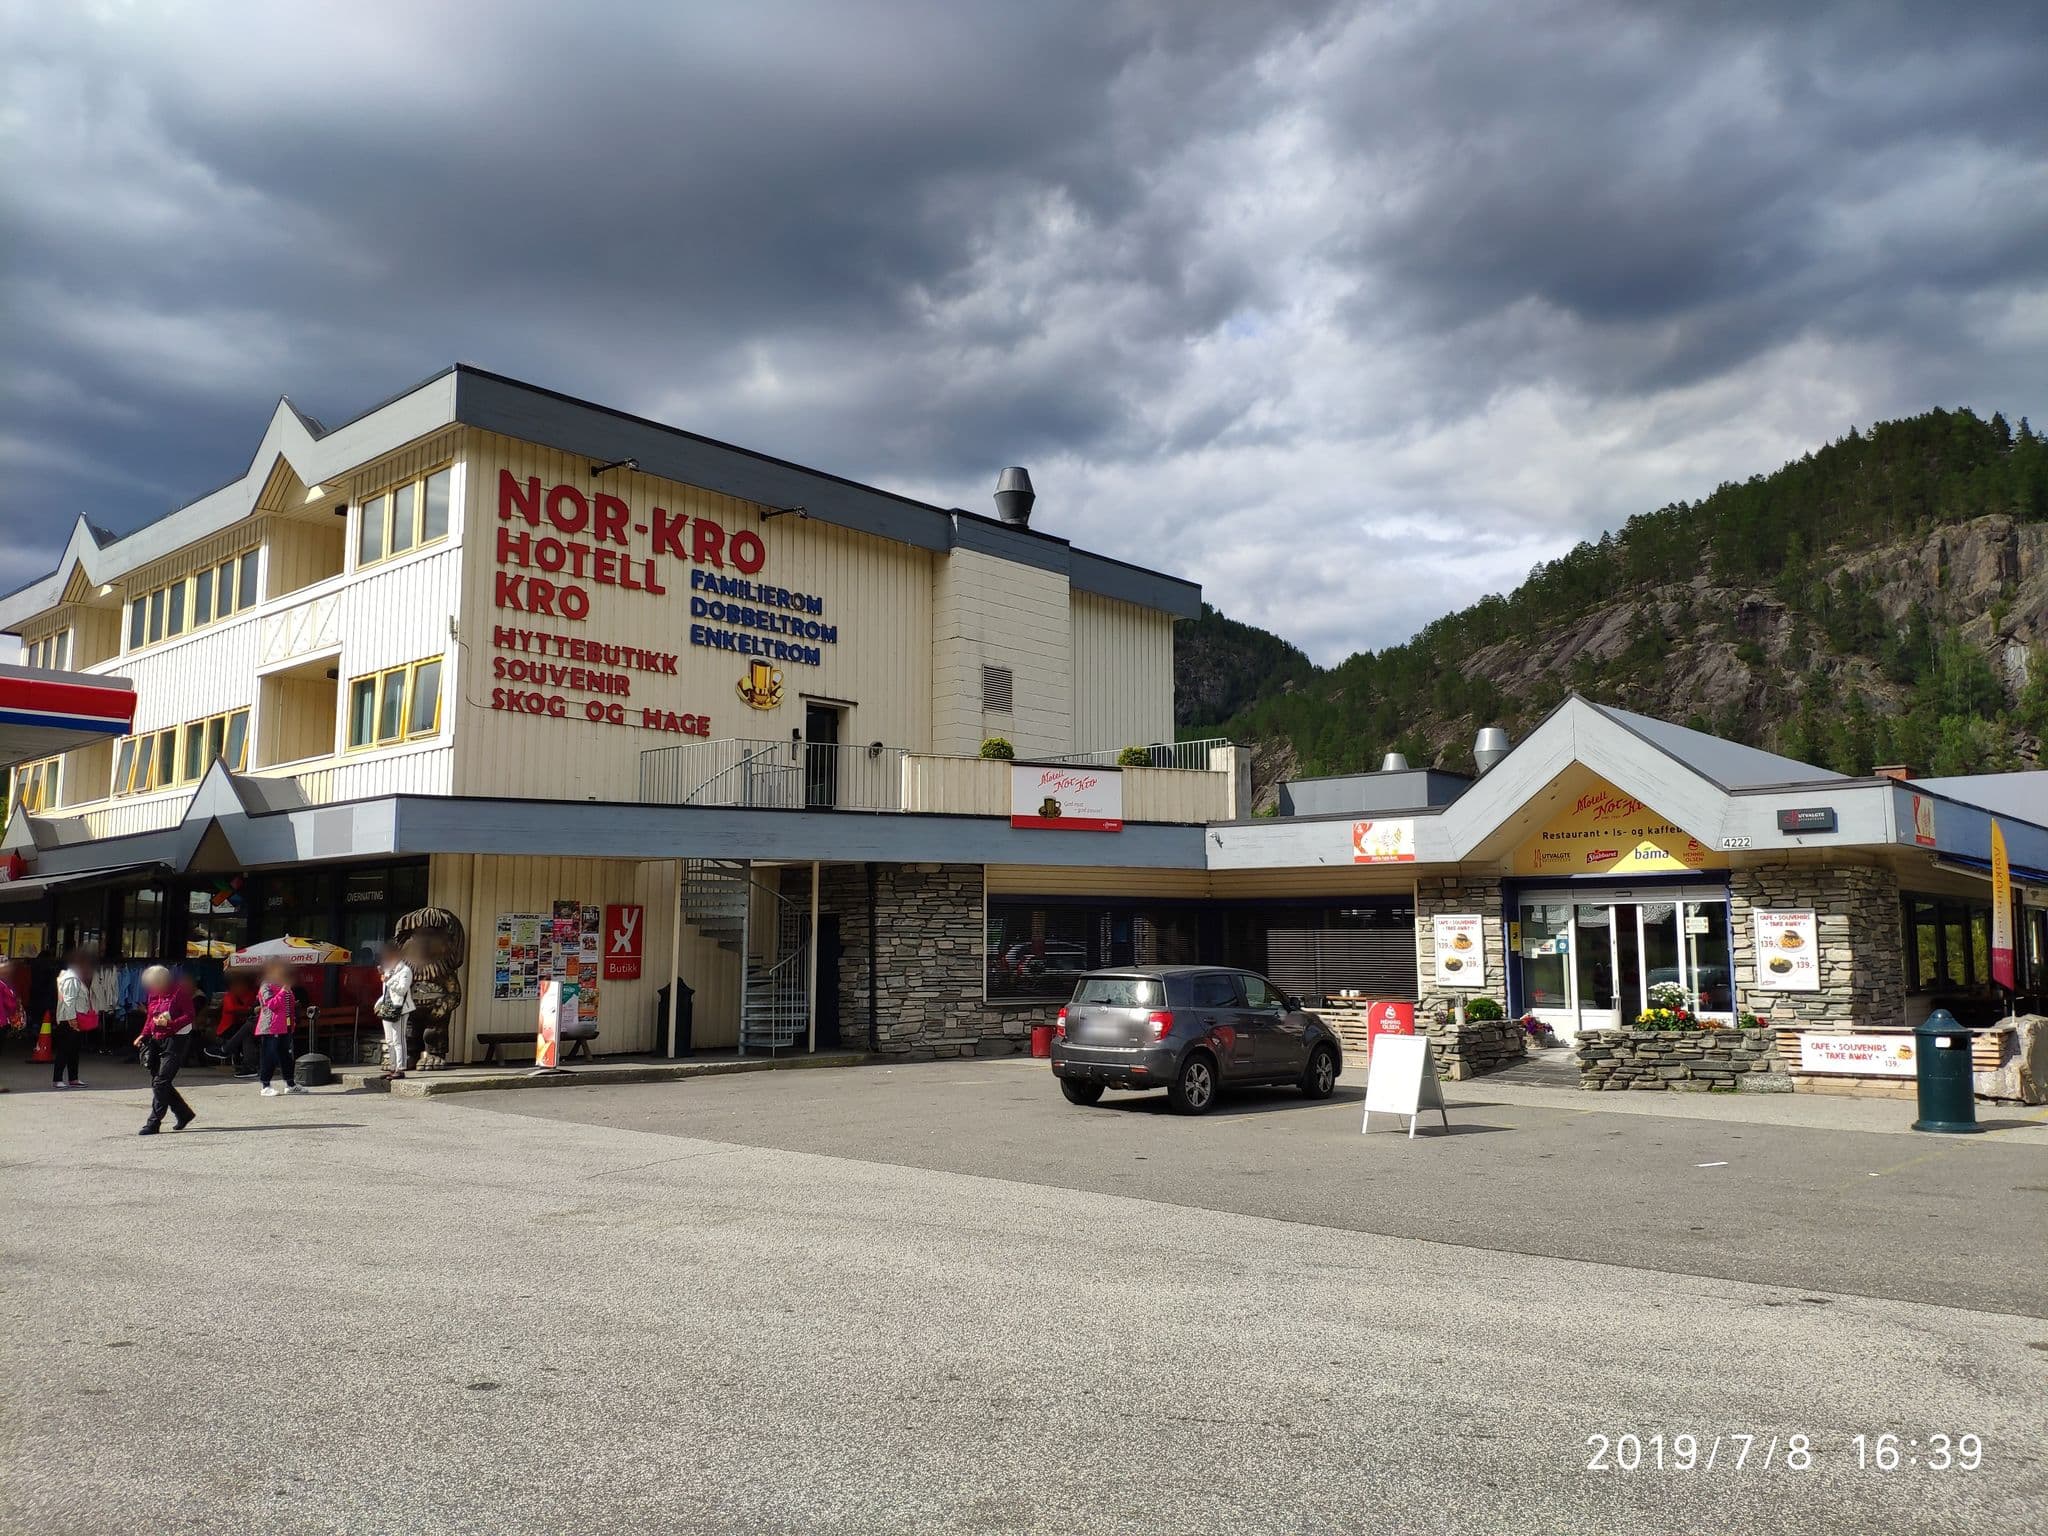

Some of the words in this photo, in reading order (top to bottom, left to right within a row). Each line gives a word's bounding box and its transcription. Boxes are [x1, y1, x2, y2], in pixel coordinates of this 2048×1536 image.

[499, 468, 766, 575] NOR-KRO
[497, 526, 666, 595] HOTELL
[495, 570, 590, 621] KRO
[691, 568, 823, 616] FAMILIEROM
[690, 596, 838, 644] DOBBELTROM
[493, 625, 679, 676] HYTTEBUTIKK
[690, 623, 821, 666] ENKELTROM
[492, 656, 631, 697] SOUVENIR
[491, 687, 566, 719] SKOG
[585, 700, 625, 725] OG
[642, 707, 711, 738] HAGE
[1593, 798, 1646, 822] Nor-Kr
[1542, 829, 1601, 841] Restaurant
[1631, 829, 1644, 838] og
[1647, 824, 1684, 835] kaffeb
[1723, 837, 1751, 848] 4222
[1542, 852, 1571, 860] UTVALGTE
[1634, 847, 1670, 861] bama
[609, 963, 638, 974] Butikk
[1810, 1042, 1831, 1050] CAFE
[1838, 1043, 1888, 1052] SOUVENIRS
[1825, 1052, 1846, 1060] TAKE
[1848, 1053, 1874, 1061] AWAY
